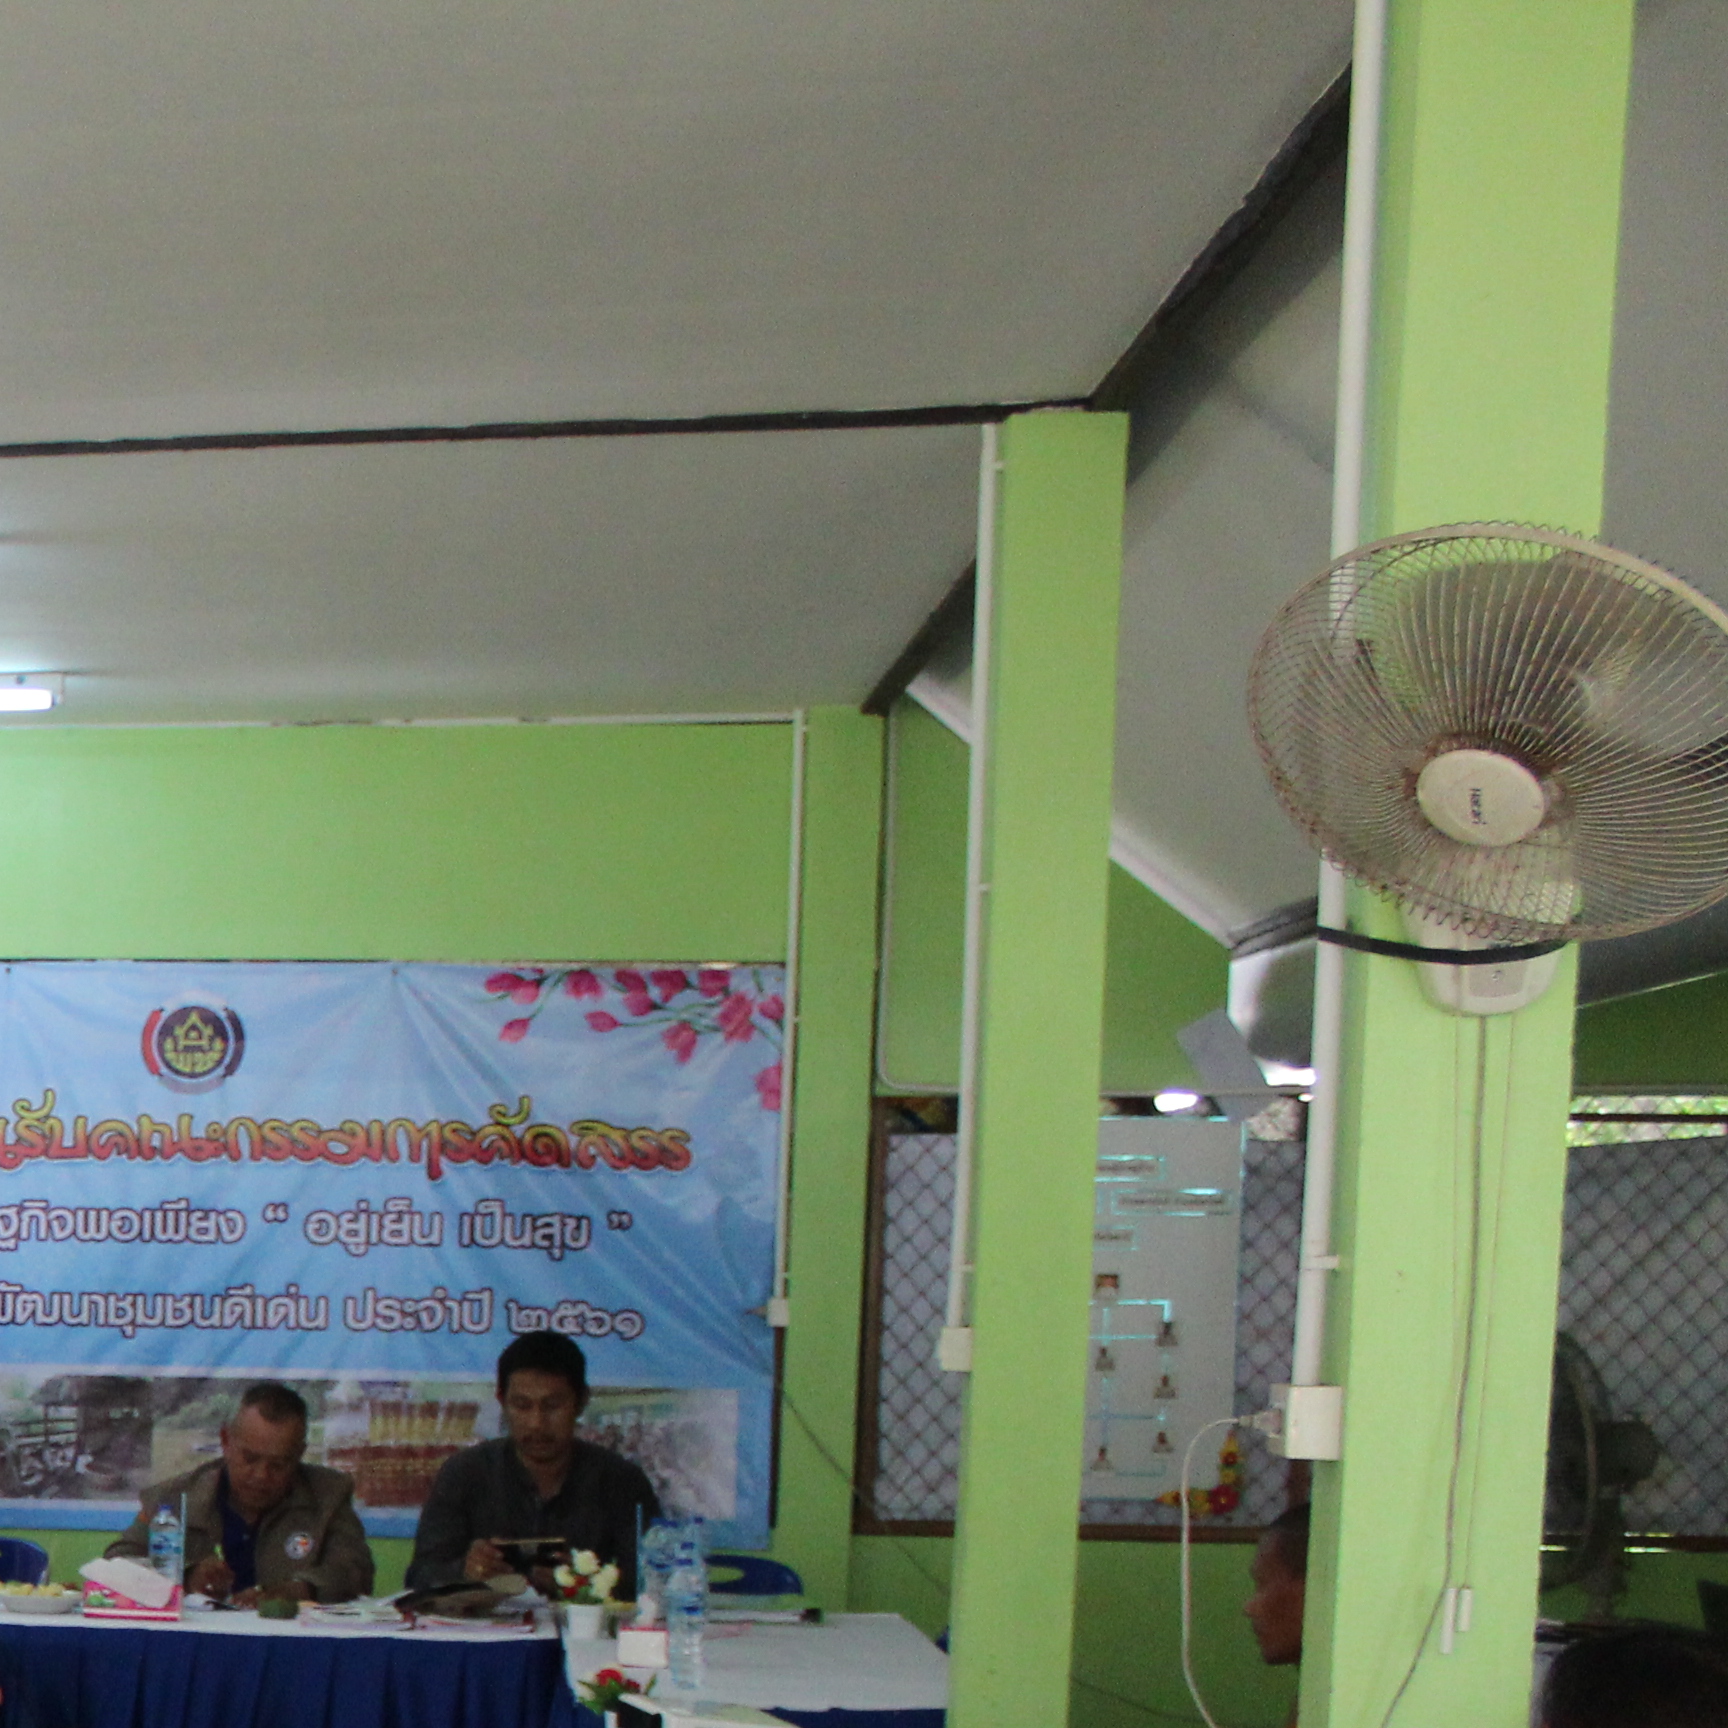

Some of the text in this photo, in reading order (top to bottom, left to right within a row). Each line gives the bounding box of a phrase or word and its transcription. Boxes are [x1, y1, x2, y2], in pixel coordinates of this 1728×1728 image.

[305, 1196, 442, 1257] อยู่เย็น
[459, 1198, 591, 1260] เป็นสุข
[345, 1287, 493, 1333] ประจำปี
